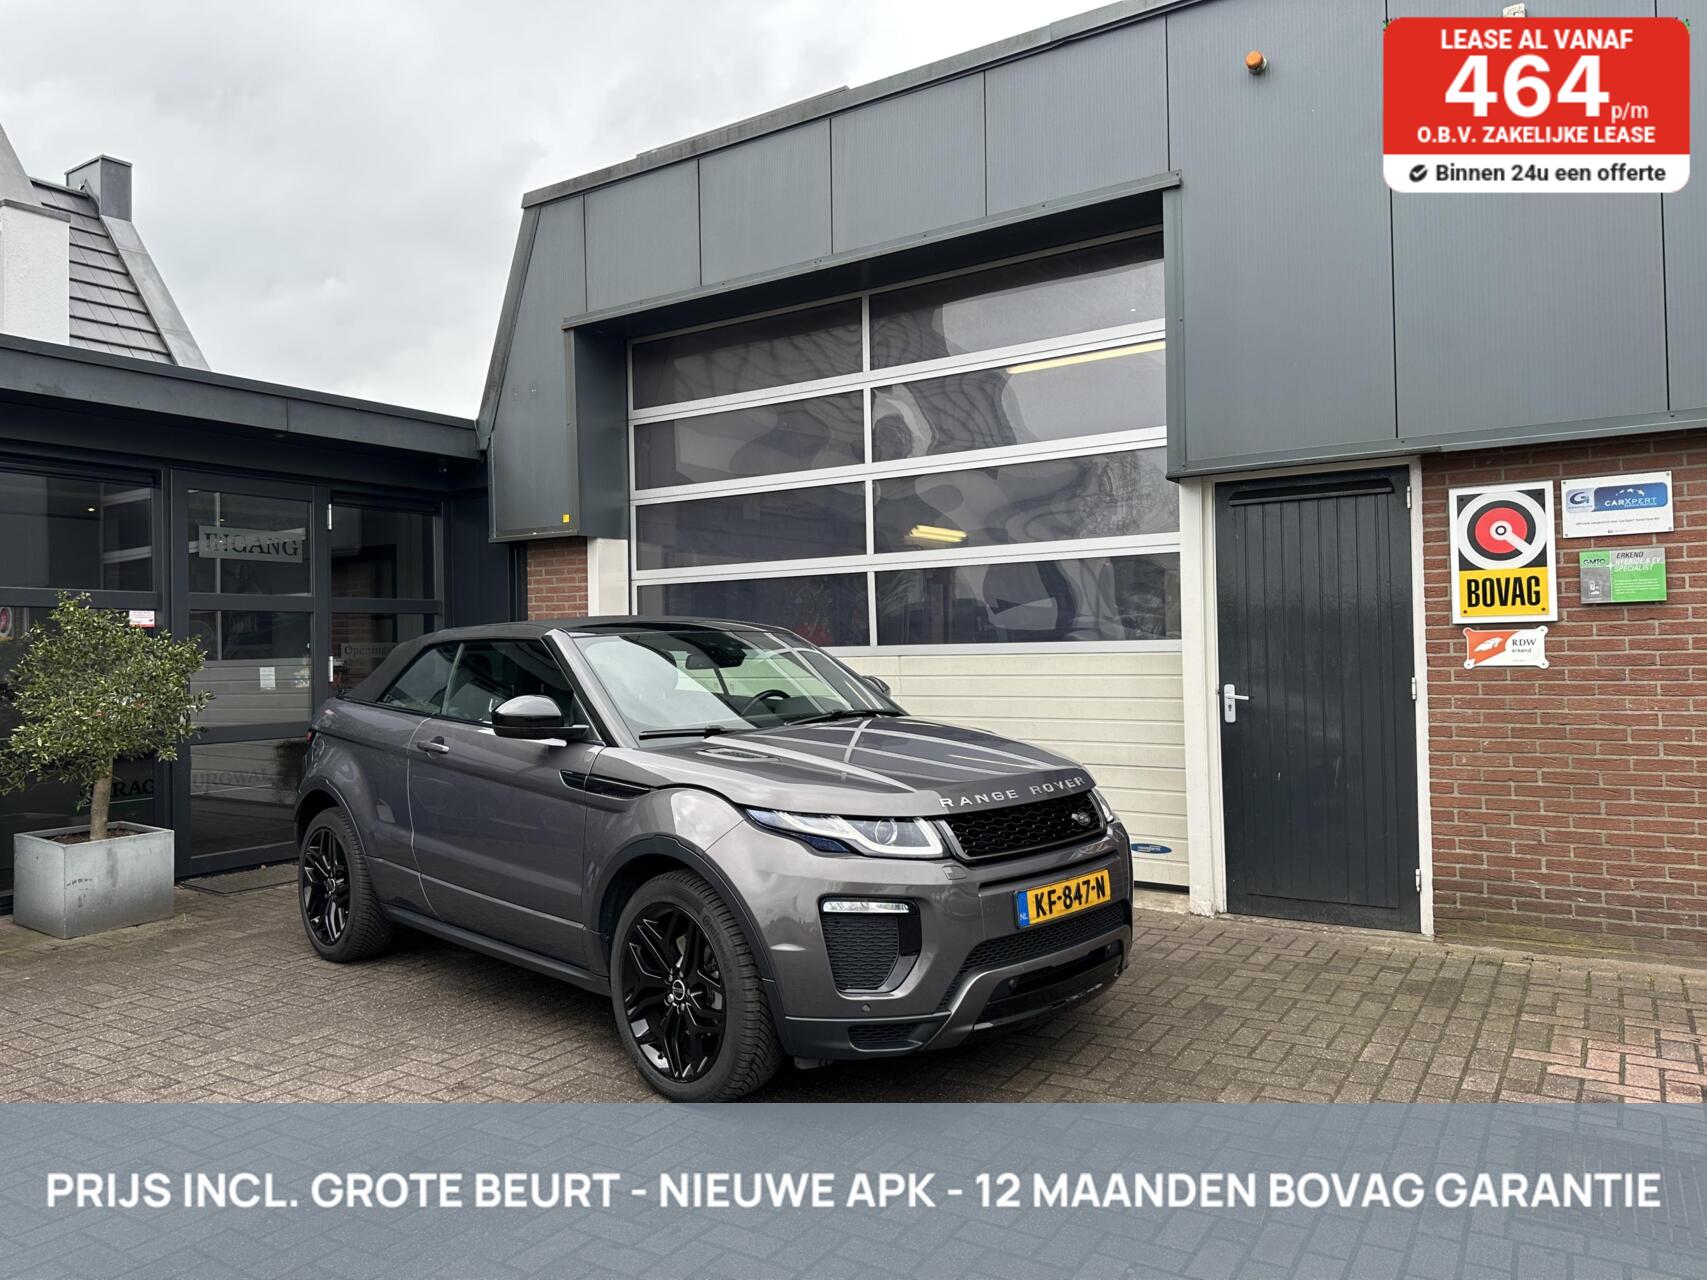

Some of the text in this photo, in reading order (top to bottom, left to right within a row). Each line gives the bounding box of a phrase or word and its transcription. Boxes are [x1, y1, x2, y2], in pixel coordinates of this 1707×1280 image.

[204, 532, 298, 557] INGANG
[1616, 551, 1644, 559] ERKEND
[1466, 575, 1541, 608] BOVAG
[1511, 638, 1537, 647] RDW
[938, 776, 1086, 808] RANGE ROVER
[1034, 874, 1106, 918] KF-847-N
[1019, 912, 1029, 921] NL
